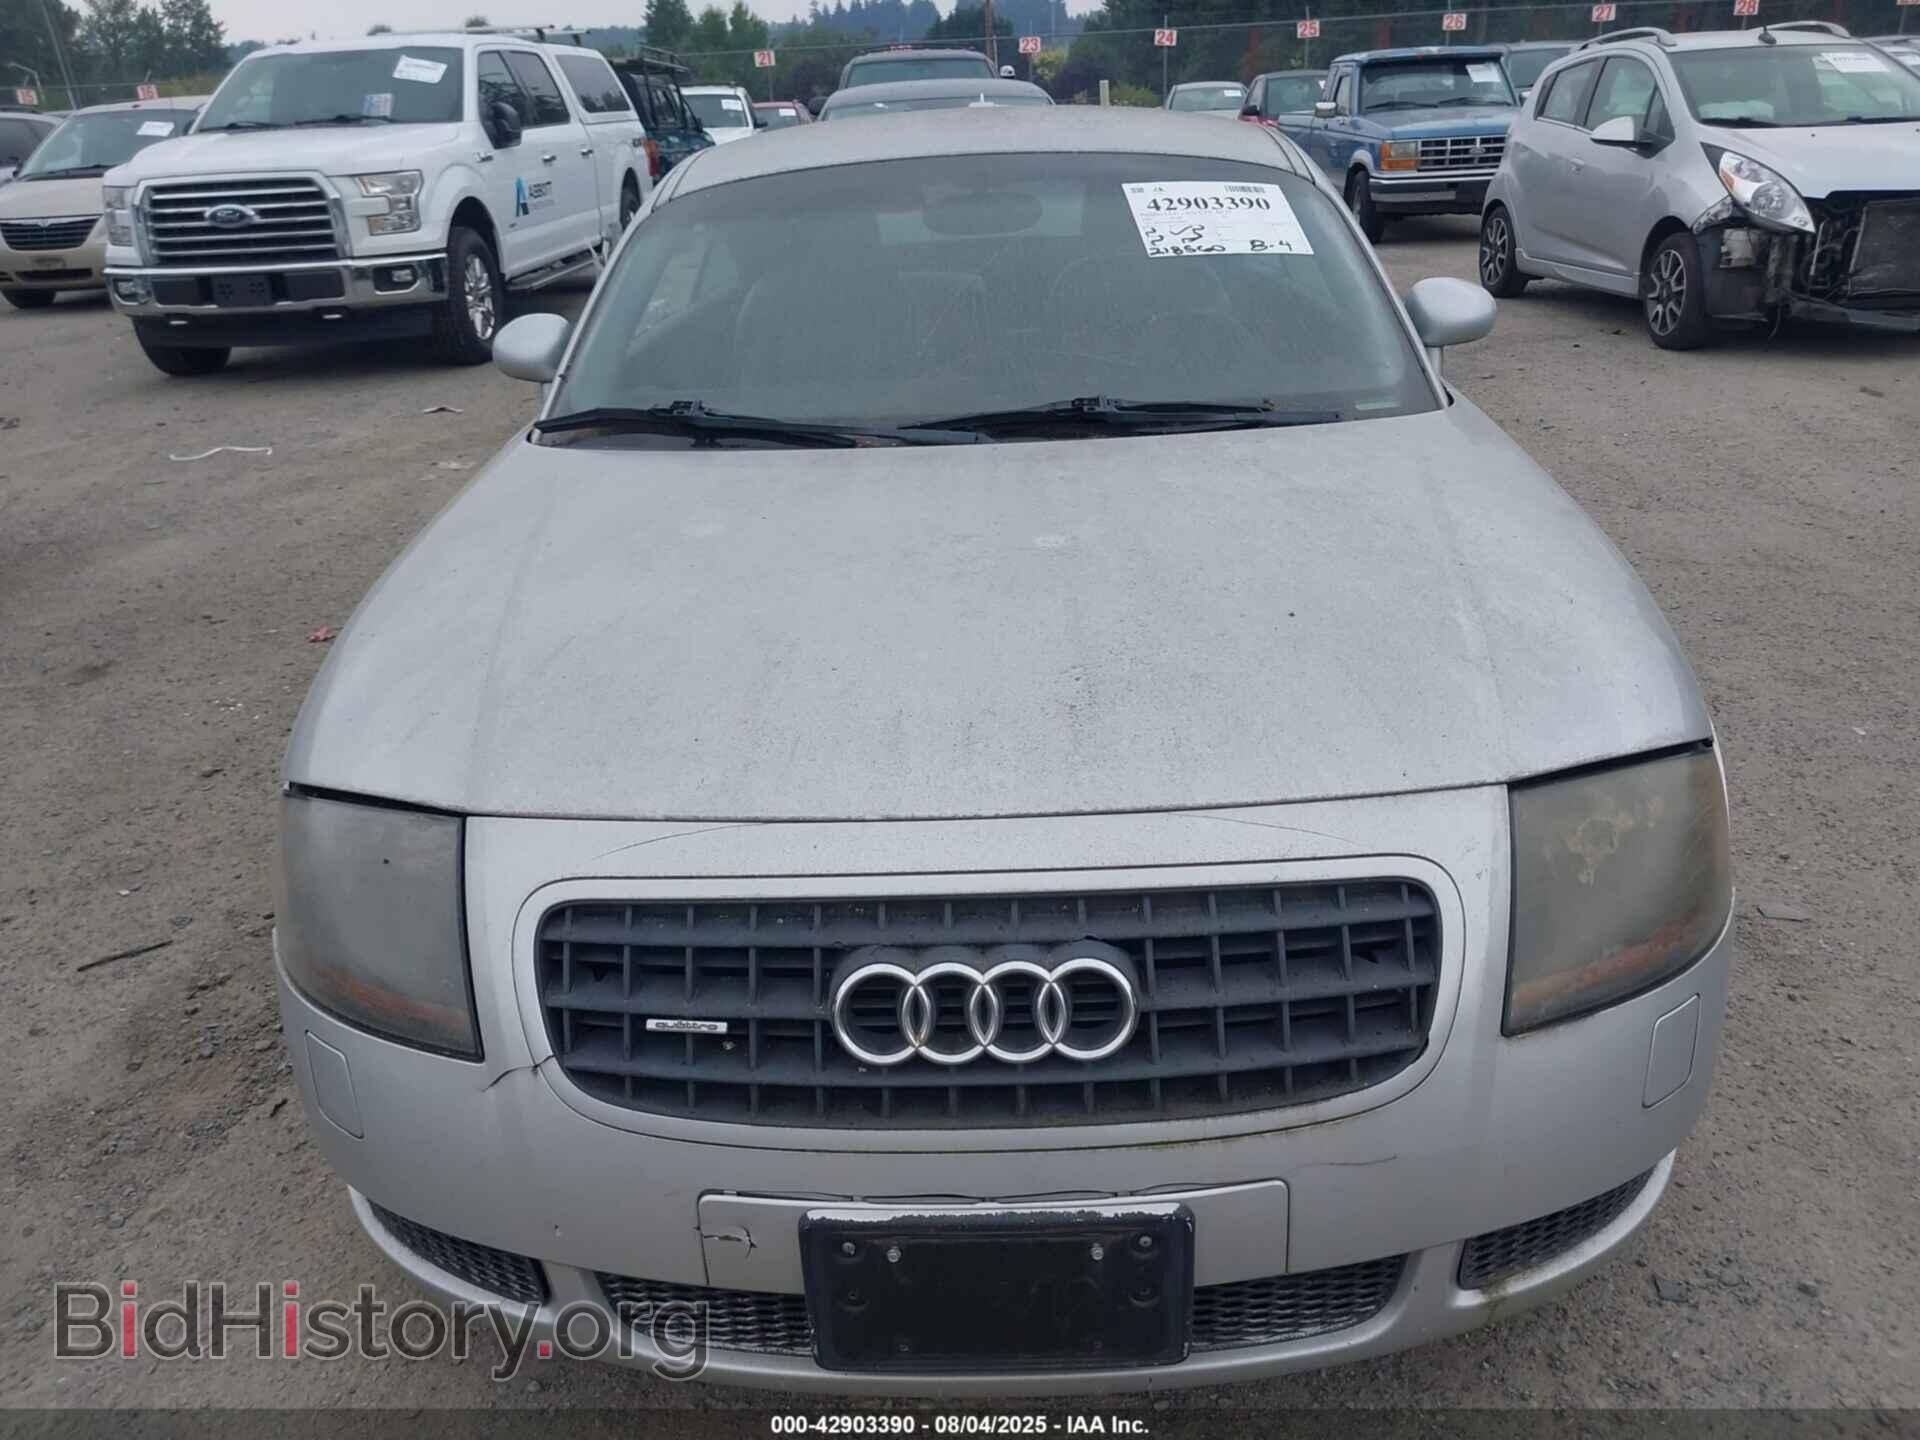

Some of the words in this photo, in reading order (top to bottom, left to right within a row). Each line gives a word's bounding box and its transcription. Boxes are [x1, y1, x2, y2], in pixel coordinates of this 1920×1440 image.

[1595, 5, 1611, 19] 27
[1736, 0, 1755, 15] 28
[1299, 22, 1316, 36] 25
[1445, 15, 1463, 29] 26
[1022, 38, 1038, 51] 23
[1157, 31, 1173, 45] 24
[757, 52, 772, 65] 21
[1146, 196, 1271, 212] 42903390
[655, 1020, 718, 1031] quattro
